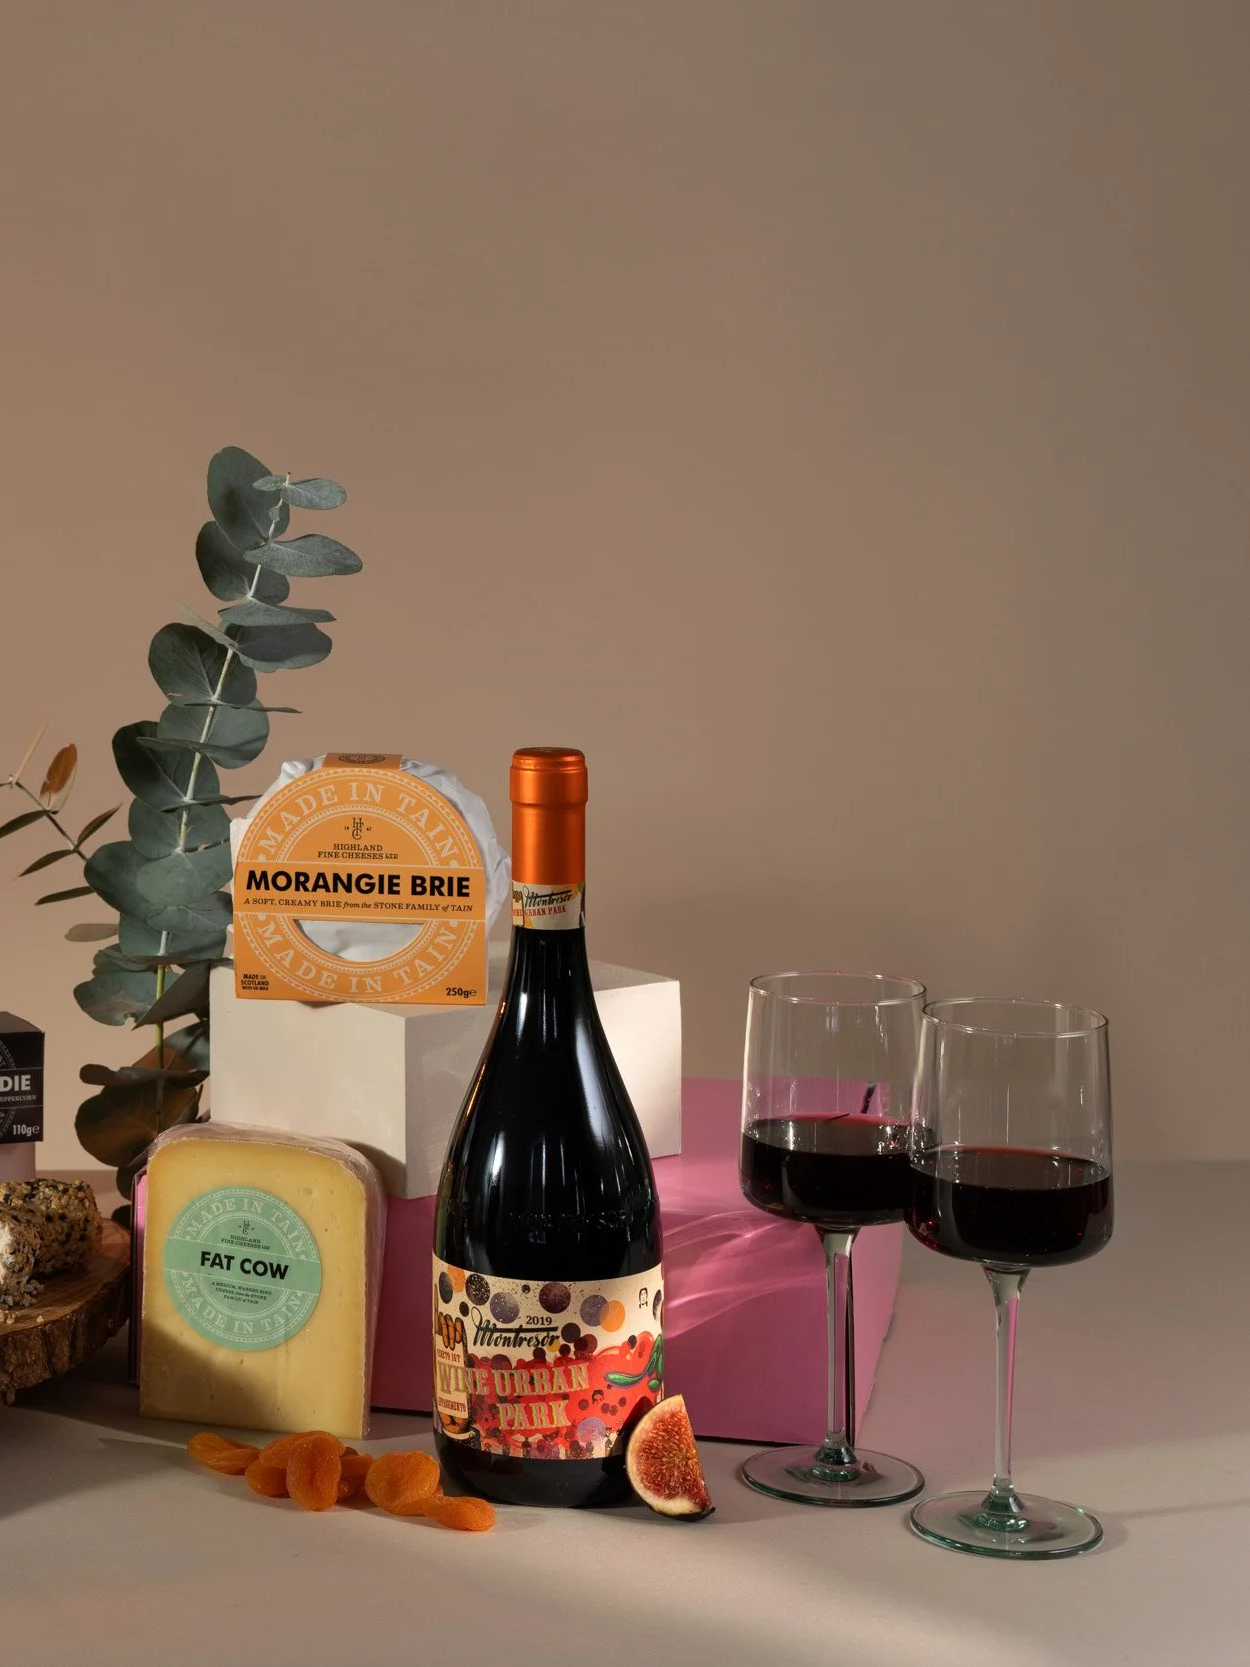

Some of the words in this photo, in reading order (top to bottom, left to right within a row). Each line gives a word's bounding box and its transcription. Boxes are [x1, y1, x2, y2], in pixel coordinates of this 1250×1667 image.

[258, 785, 339, 854] MADE
[349, 782, 385, 803] IN
[398, 793, 457, 858] TAIN
[318, 851, 340, 859] FINE
[341, 851, 384, 859] CHEESES
[333, 843, 383, 851] HIGHLAND
[246, 870, 400, 895] MORANGIE
[411, 875, 470, 897] BRIE
[523, 885, 572, 908] Montresor
[252, 898, 277, 906] SOFT,
[278, 899, 318, 907] CREAMY
[320, 900, 342, 908] BRIE
[342, 901, 360, 909] from
[373, 902, 404, 910] STONE
[405, 903, 440, 911] FAMILY
[442, 904, 450, 912] of
[548, 905, 567, 915] PARK
[257, 921, 338, 990] MADE
[351, 977, 383, 993] IN
[393, 929, 457, 985] TAIN
[187, 1198, 236, 1236] MADE
[242, 1199, 264, 1213] IN
[270, 1210, 308, 1256] TAIN
[230, 1234, 261, 1244] HIGHLAND
[221, 1237, 235, 1245] FINE
[235, 1241, 261, 1250] CHEESES
[200, 1251, 235, 1271] FAT
[239, 1258, 289, 1280] COW
[181, 1278, 227, 1328] MADE
[233, 1320, 254, 1334] IN
[260, 1301, 301, 1332] TAIN
[471, 1306, 560, 1348] Montresor
[525, 1315, 553, 1326] 2019
[437, 1361, 490, 1396] WINE
[492, 1363, 590, 1397] URBAN
[496, 1400, 572, 1431] PARK
